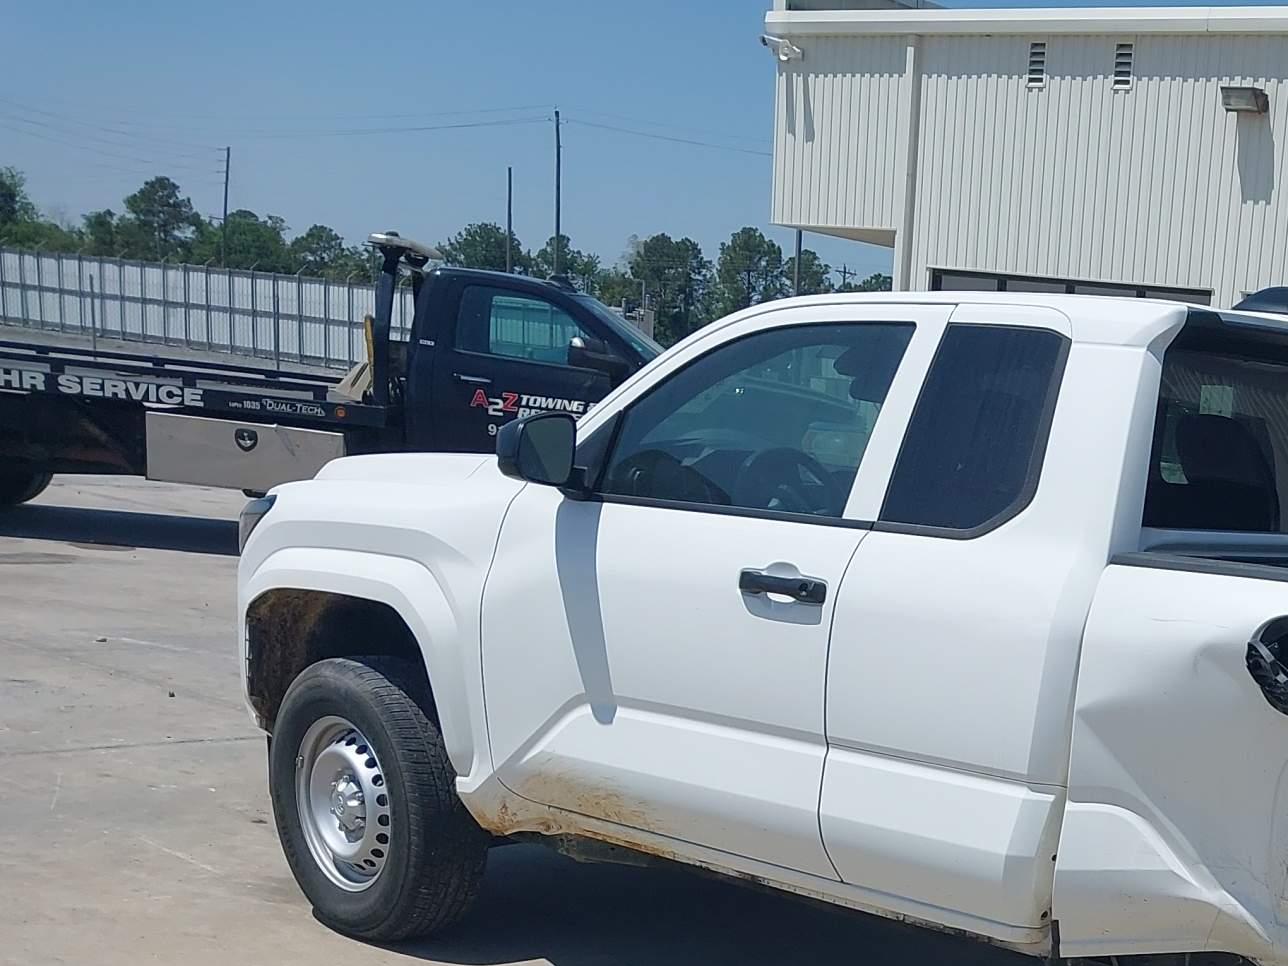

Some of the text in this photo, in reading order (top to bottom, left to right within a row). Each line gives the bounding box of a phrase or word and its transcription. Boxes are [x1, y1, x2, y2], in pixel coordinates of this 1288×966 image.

[57, 374, 204, 407] SERVICE
[470, 389, 518, 416] A2Z
[519, 394, 585, 412] TOWING
